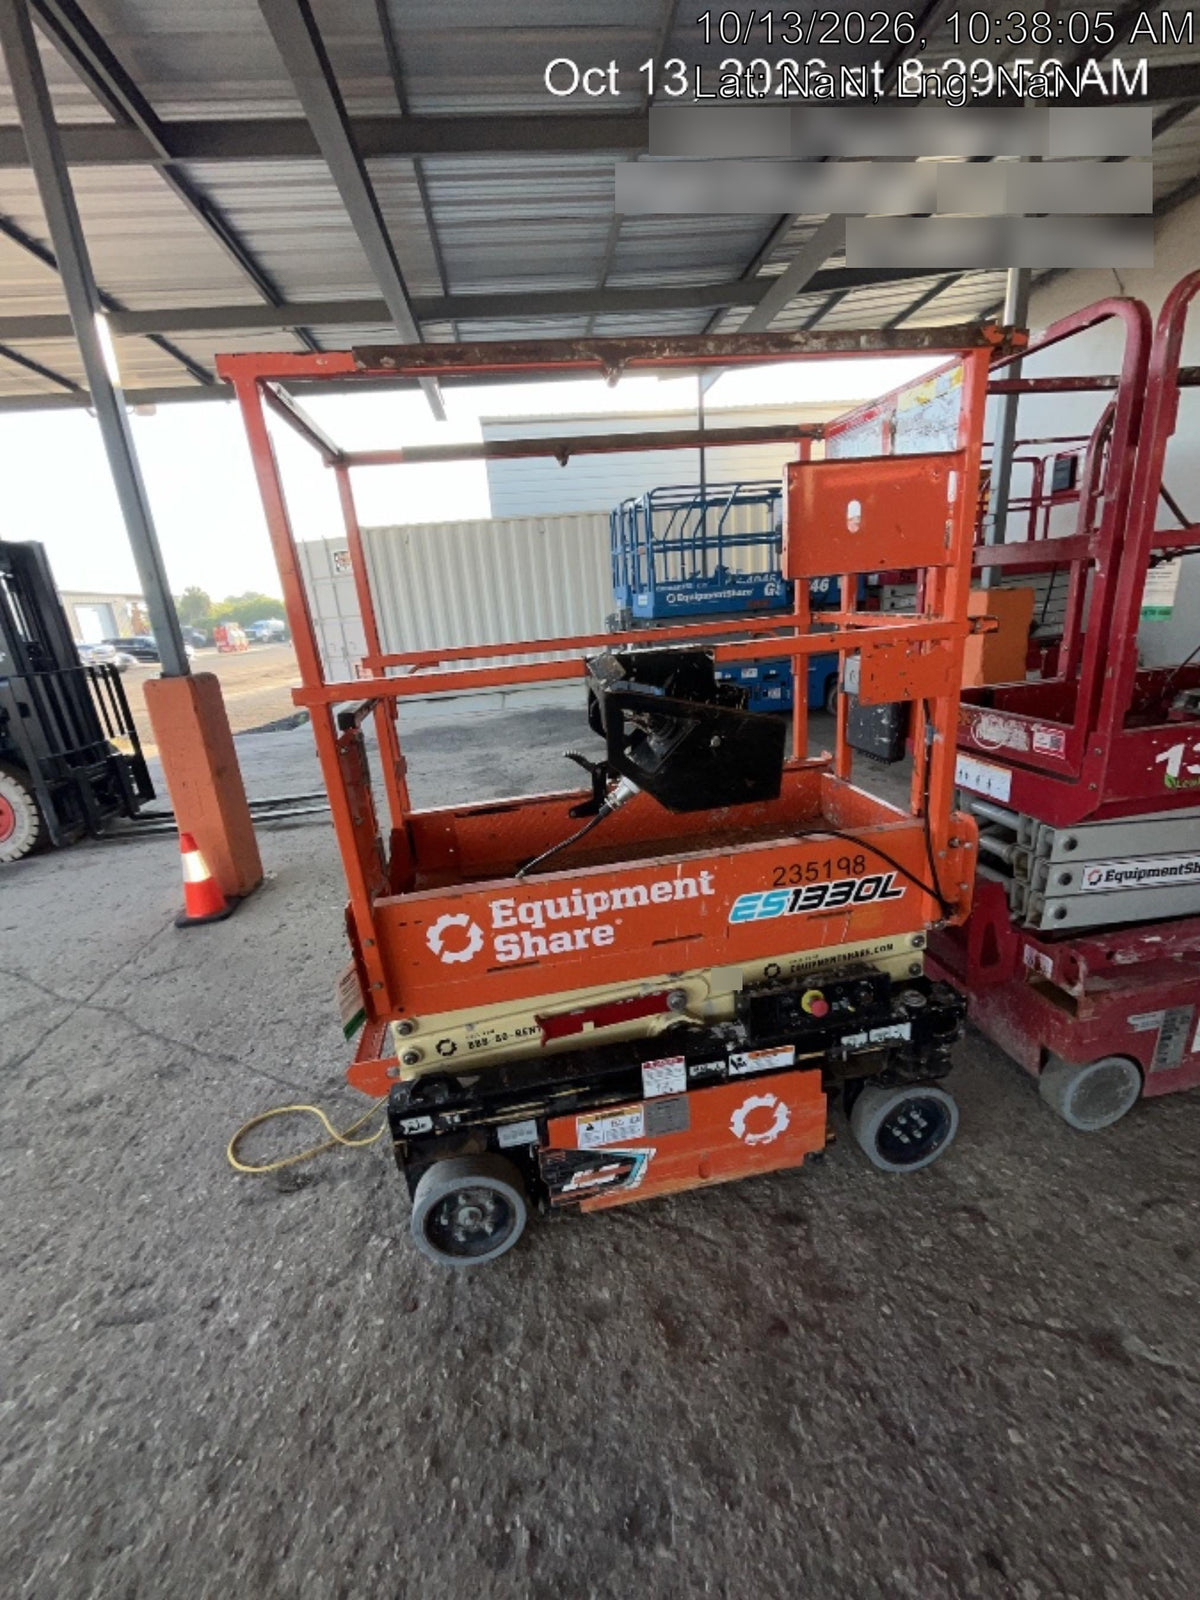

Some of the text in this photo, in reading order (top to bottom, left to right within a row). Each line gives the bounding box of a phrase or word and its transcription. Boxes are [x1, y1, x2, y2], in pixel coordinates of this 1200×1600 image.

[772, 854, 866, 887] 235198
[489, 870, 716, 929] Equipment
[729, 871, 906, 924] ES1330L
[493, 923, 615, 962] Share
